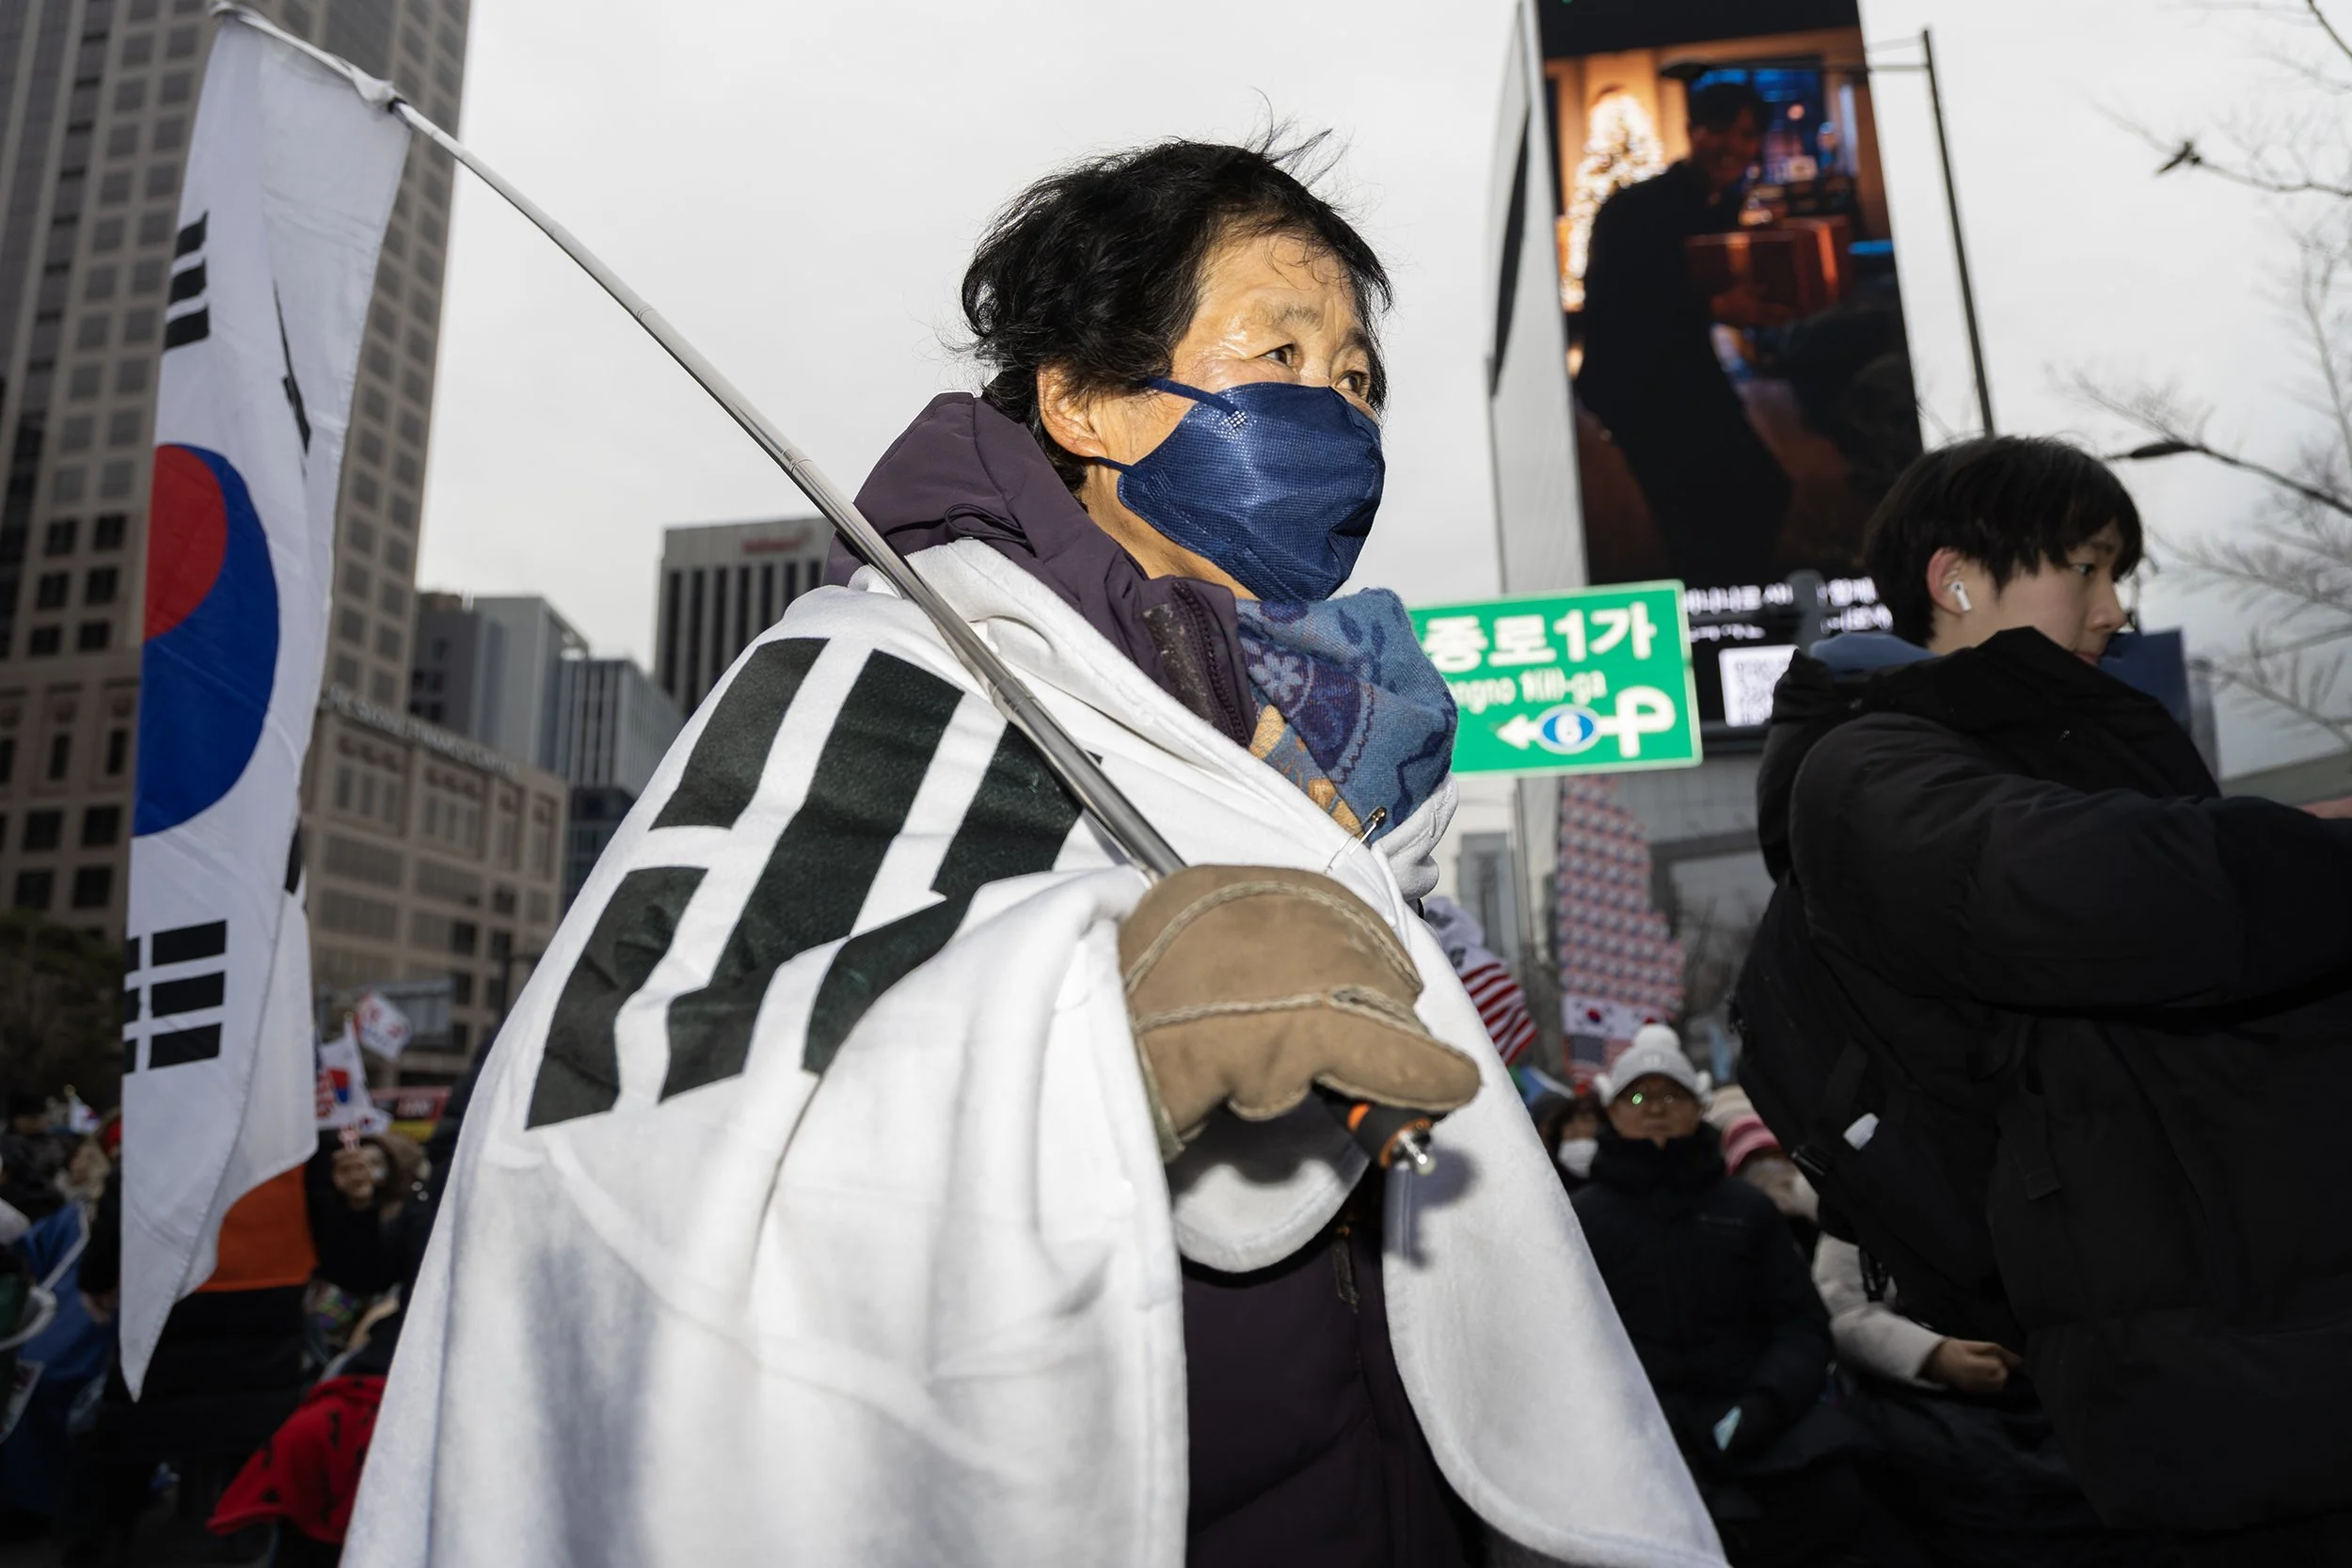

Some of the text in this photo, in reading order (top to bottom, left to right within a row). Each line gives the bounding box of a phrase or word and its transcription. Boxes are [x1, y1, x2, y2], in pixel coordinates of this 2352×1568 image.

[1422, 601, 1658, 673] 종로1가
[1447, 676, 1517, 715] ngno
[1554, 712, 1582, 747] 6
